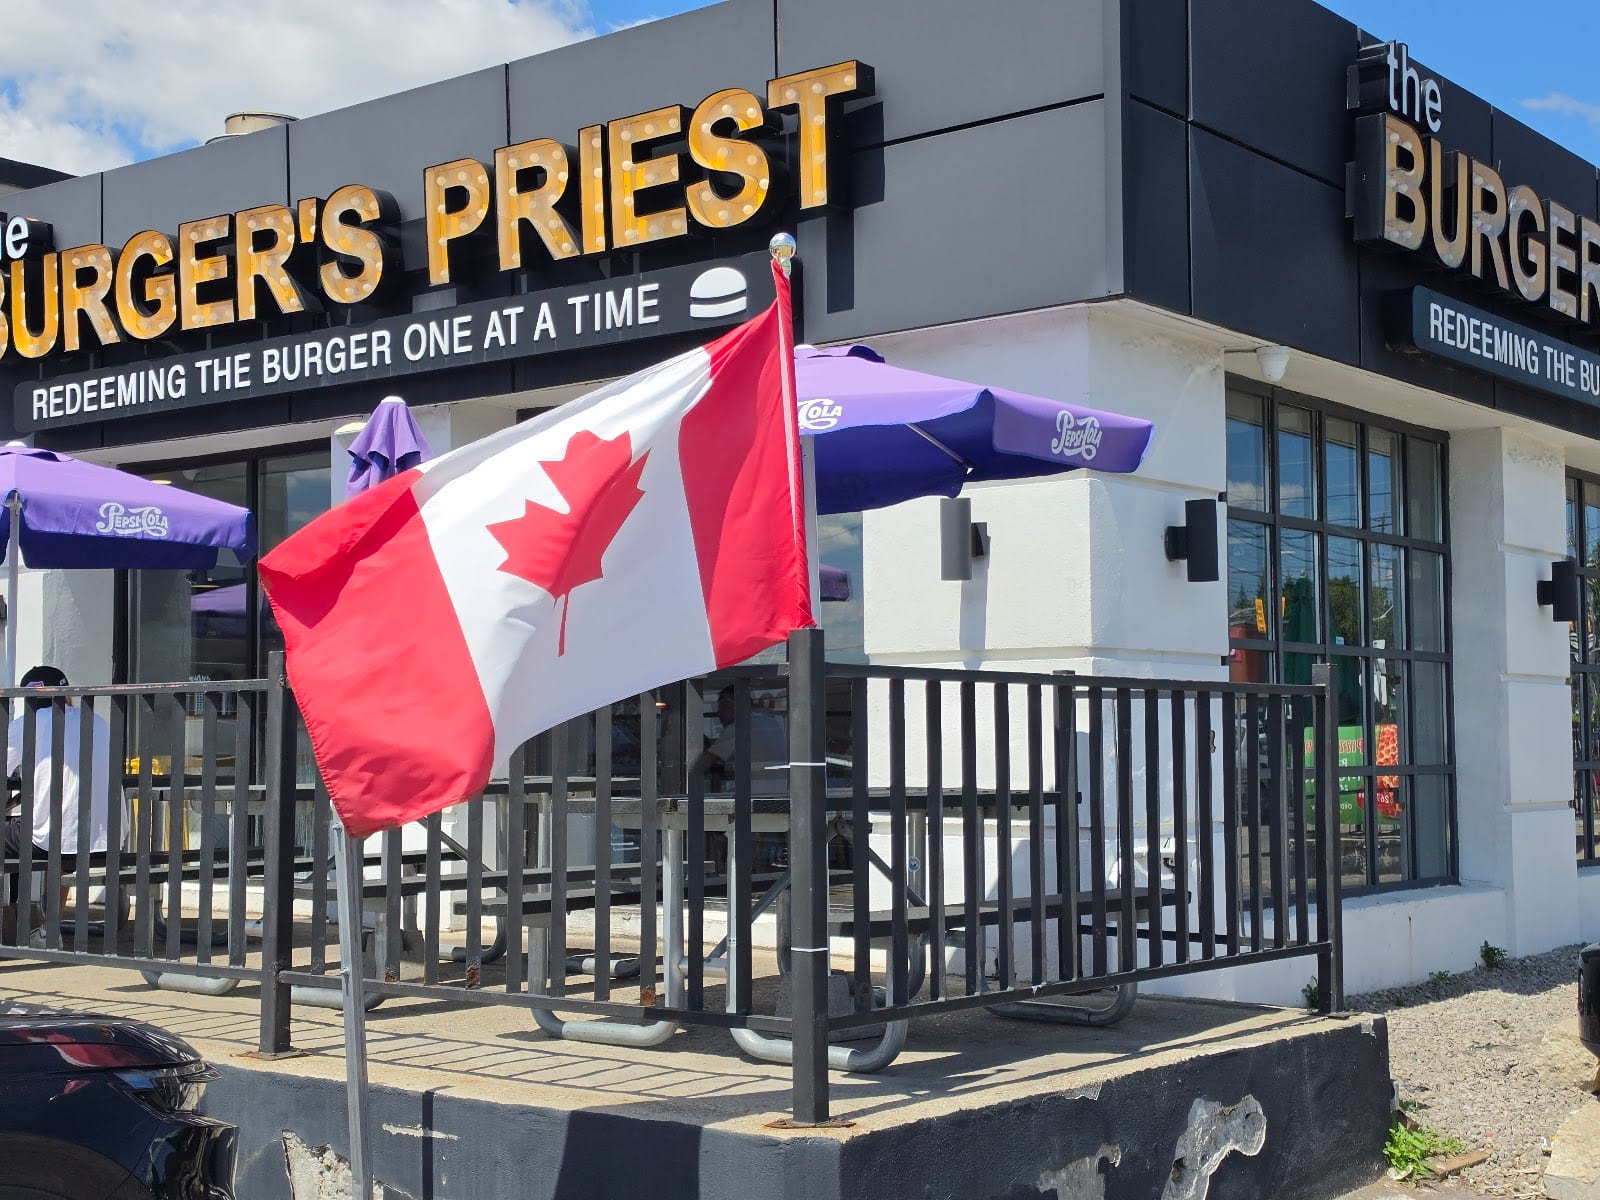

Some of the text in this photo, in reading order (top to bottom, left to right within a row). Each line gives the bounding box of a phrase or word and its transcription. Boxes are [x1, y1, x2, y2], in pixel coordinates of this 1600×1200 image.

[1387, 41, 1441, 132] the
[424, 59, 857, 286] PRIEST
[32, 283, 661, 421] REDEEMING THE BURGER ONE AT A TIME
[1429, 302, 1539, 375] REDEEMING
[1543, 345, 1576, 388] THE
